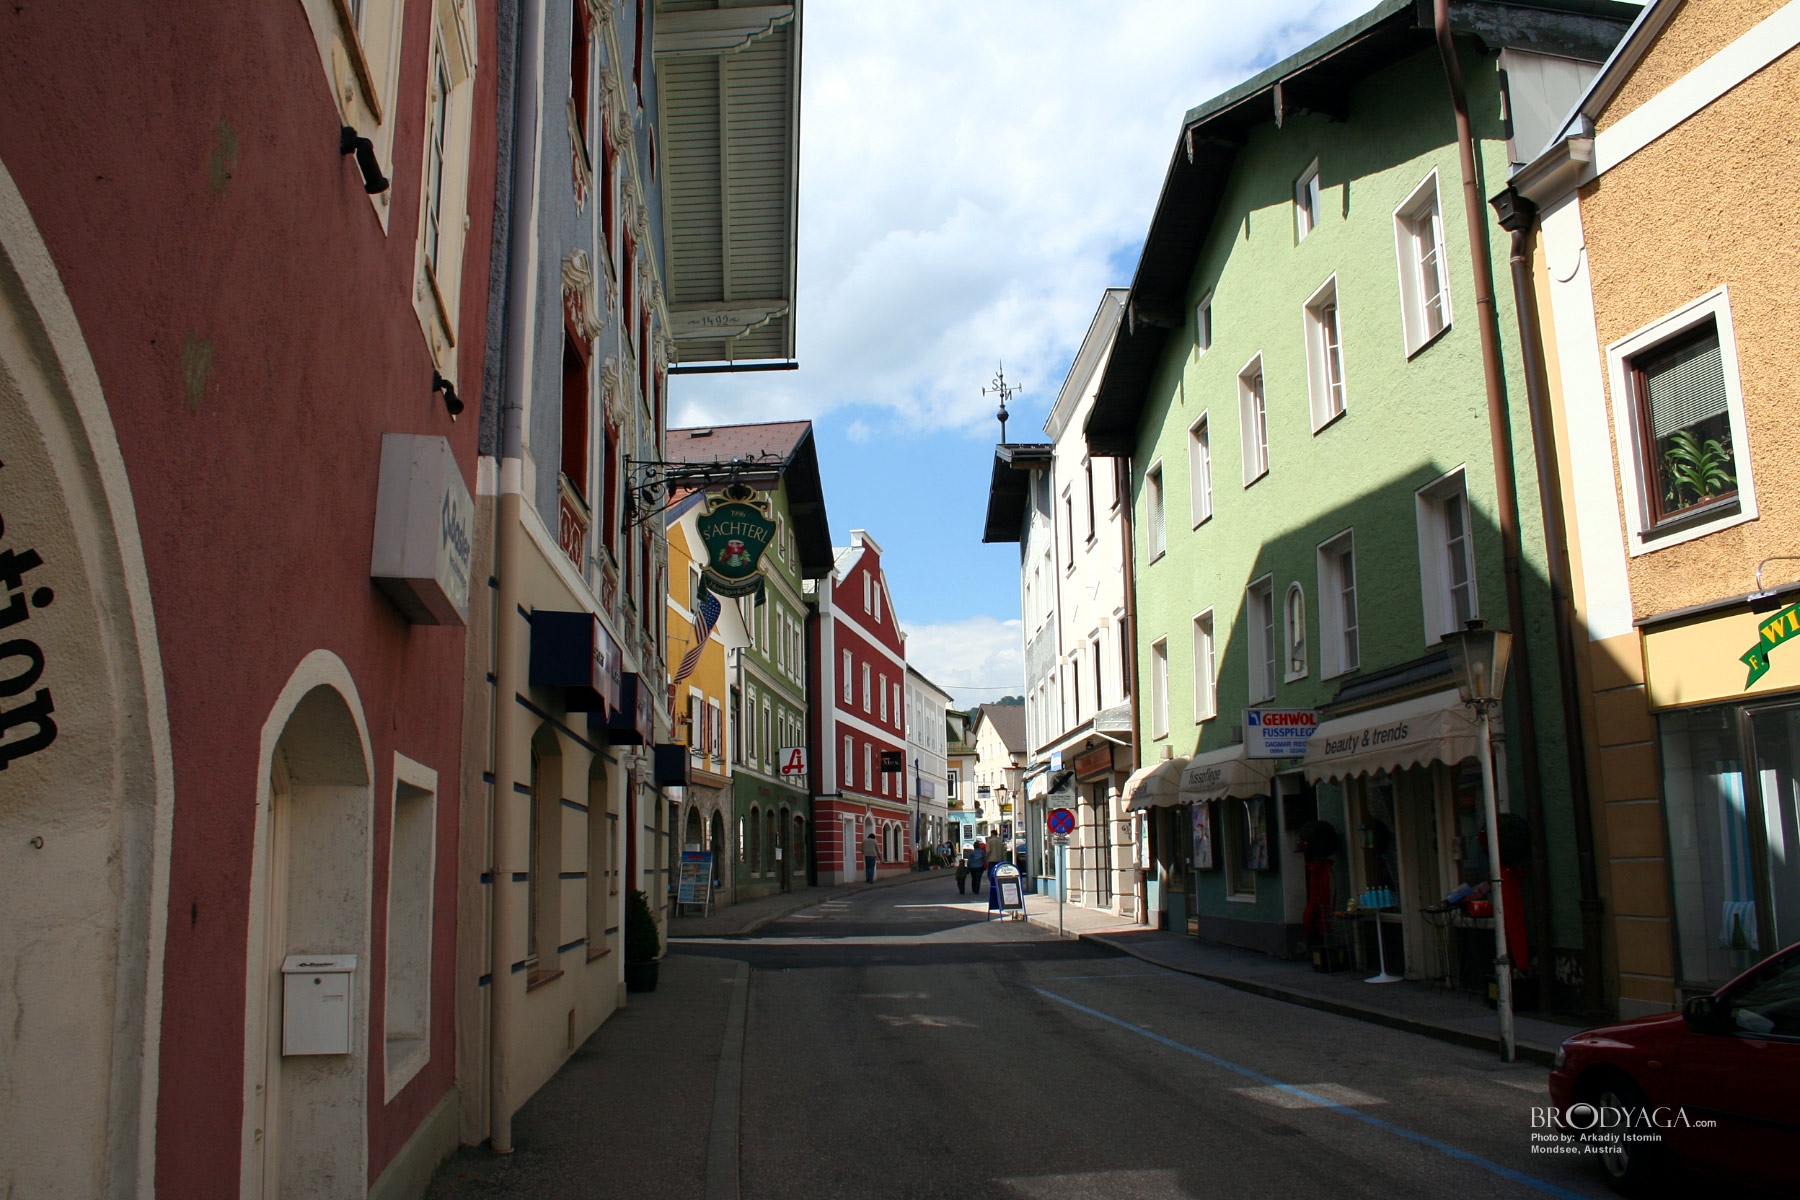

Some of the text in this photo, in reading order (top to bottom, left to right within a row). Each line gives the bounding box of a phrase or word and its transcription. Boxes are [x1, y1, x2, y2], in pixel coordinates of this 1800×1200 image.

[1760, 607, 1800, 643] WI
[1262, 712, 1317, 726] GEHWOL
[1325, 722, 1409, 755] beauty & trends
